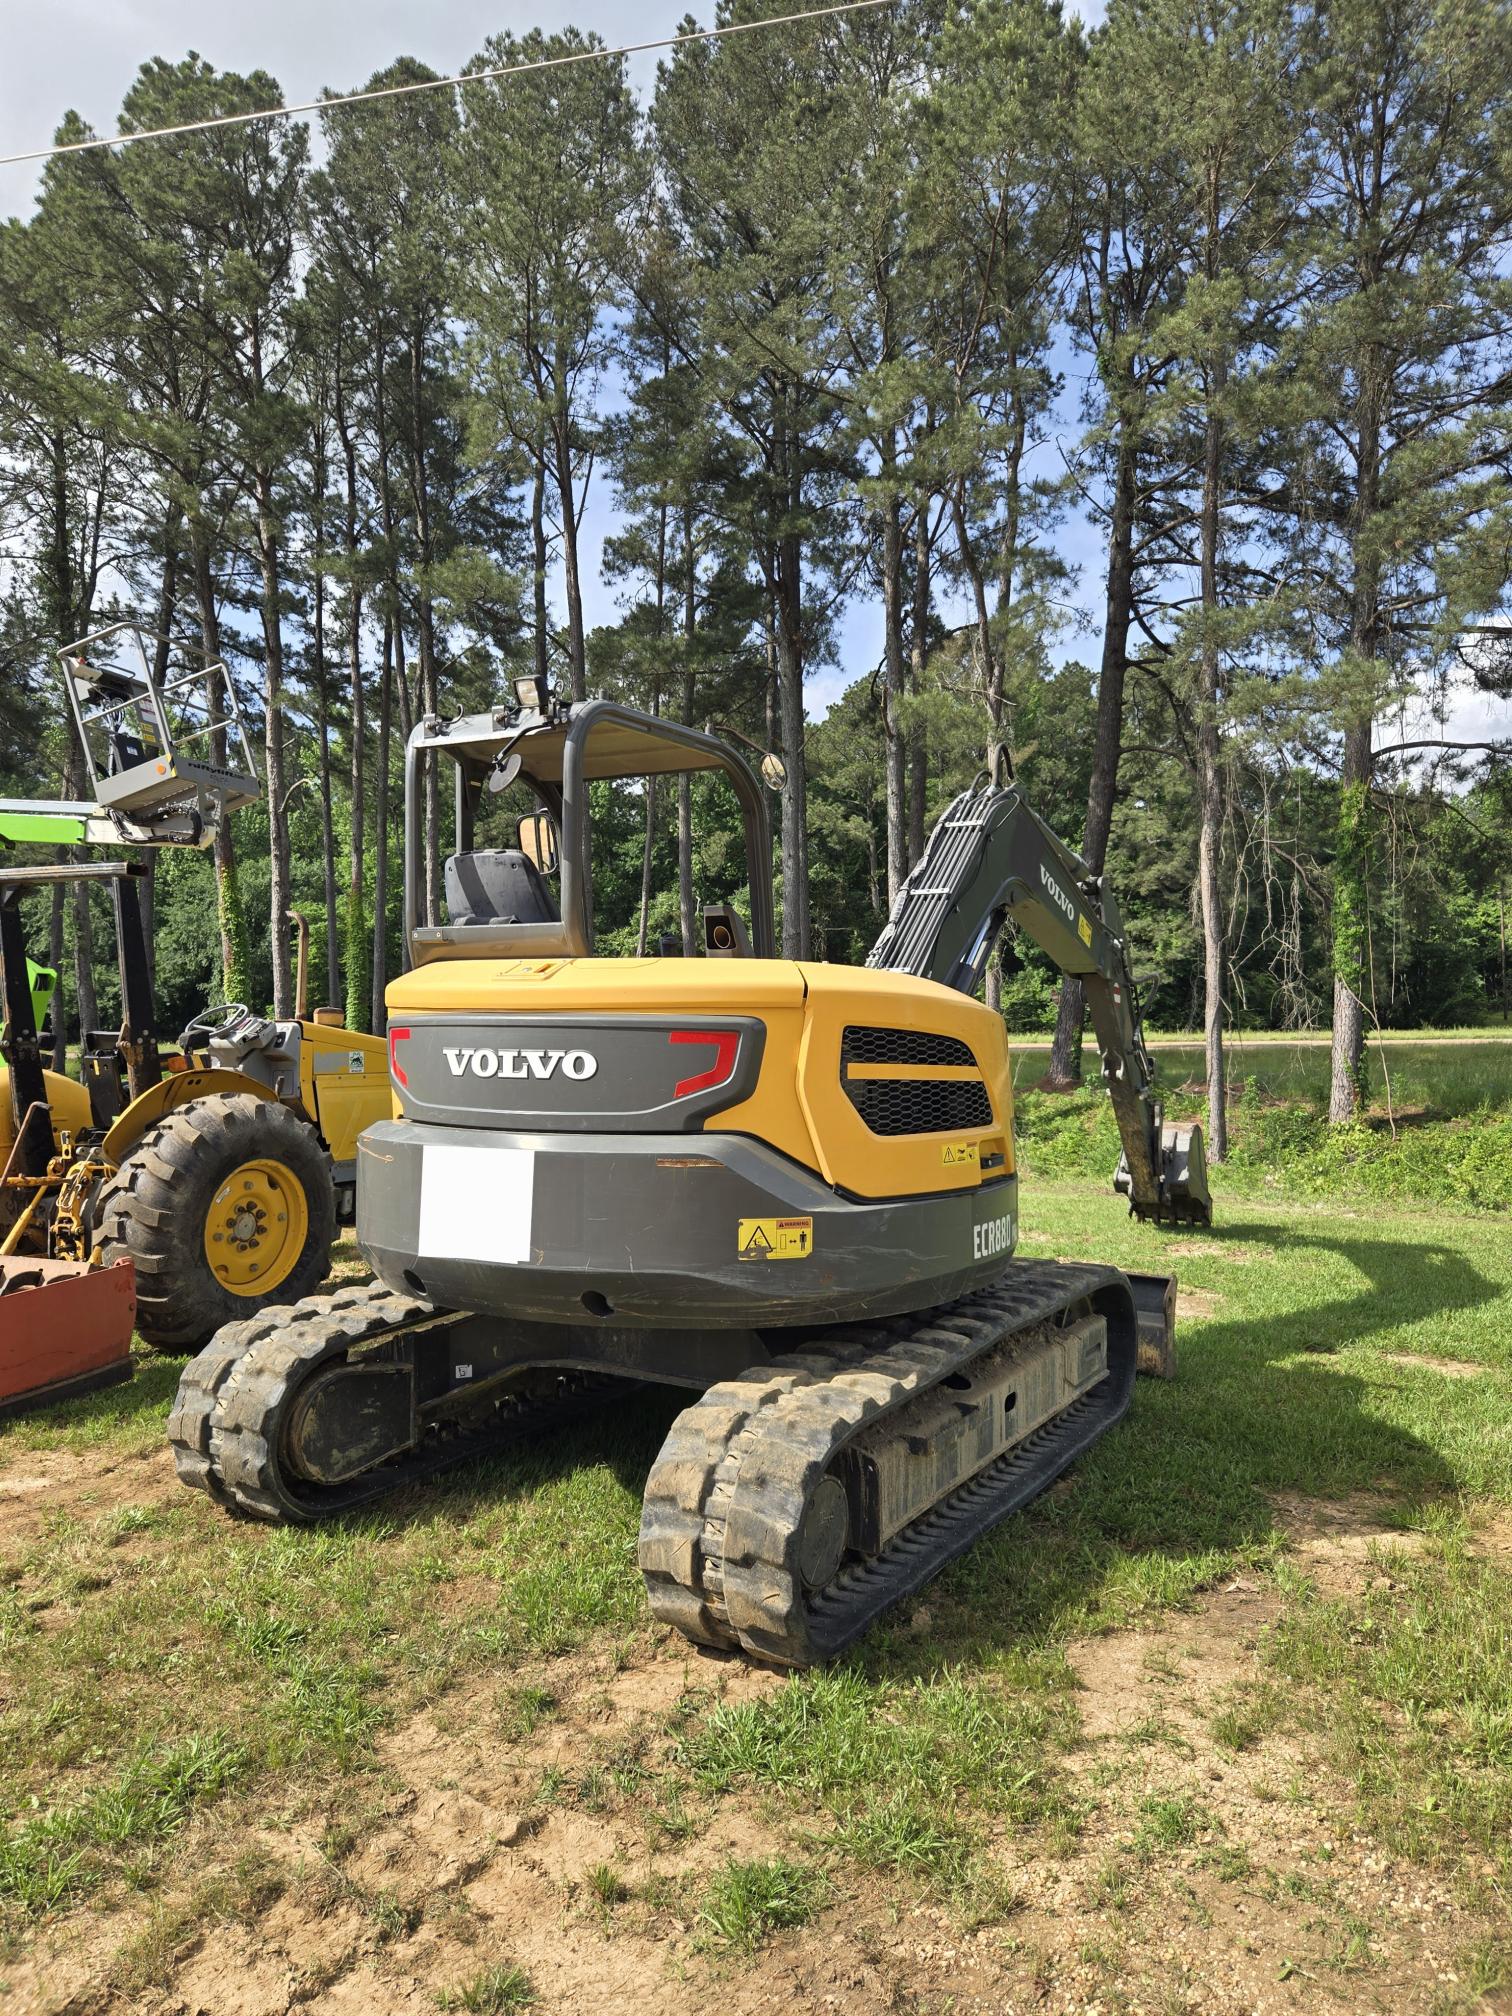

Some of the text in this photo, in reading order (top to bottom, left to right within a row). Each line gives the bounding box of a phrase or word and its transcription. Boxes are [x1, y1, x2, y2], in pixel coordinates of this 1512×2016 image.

[1040, 863, 1075, 920] VOLVO
[443, 1048, 597, 1080] VOLVO
[974, 1214, 1011, 1260] ECR88D
